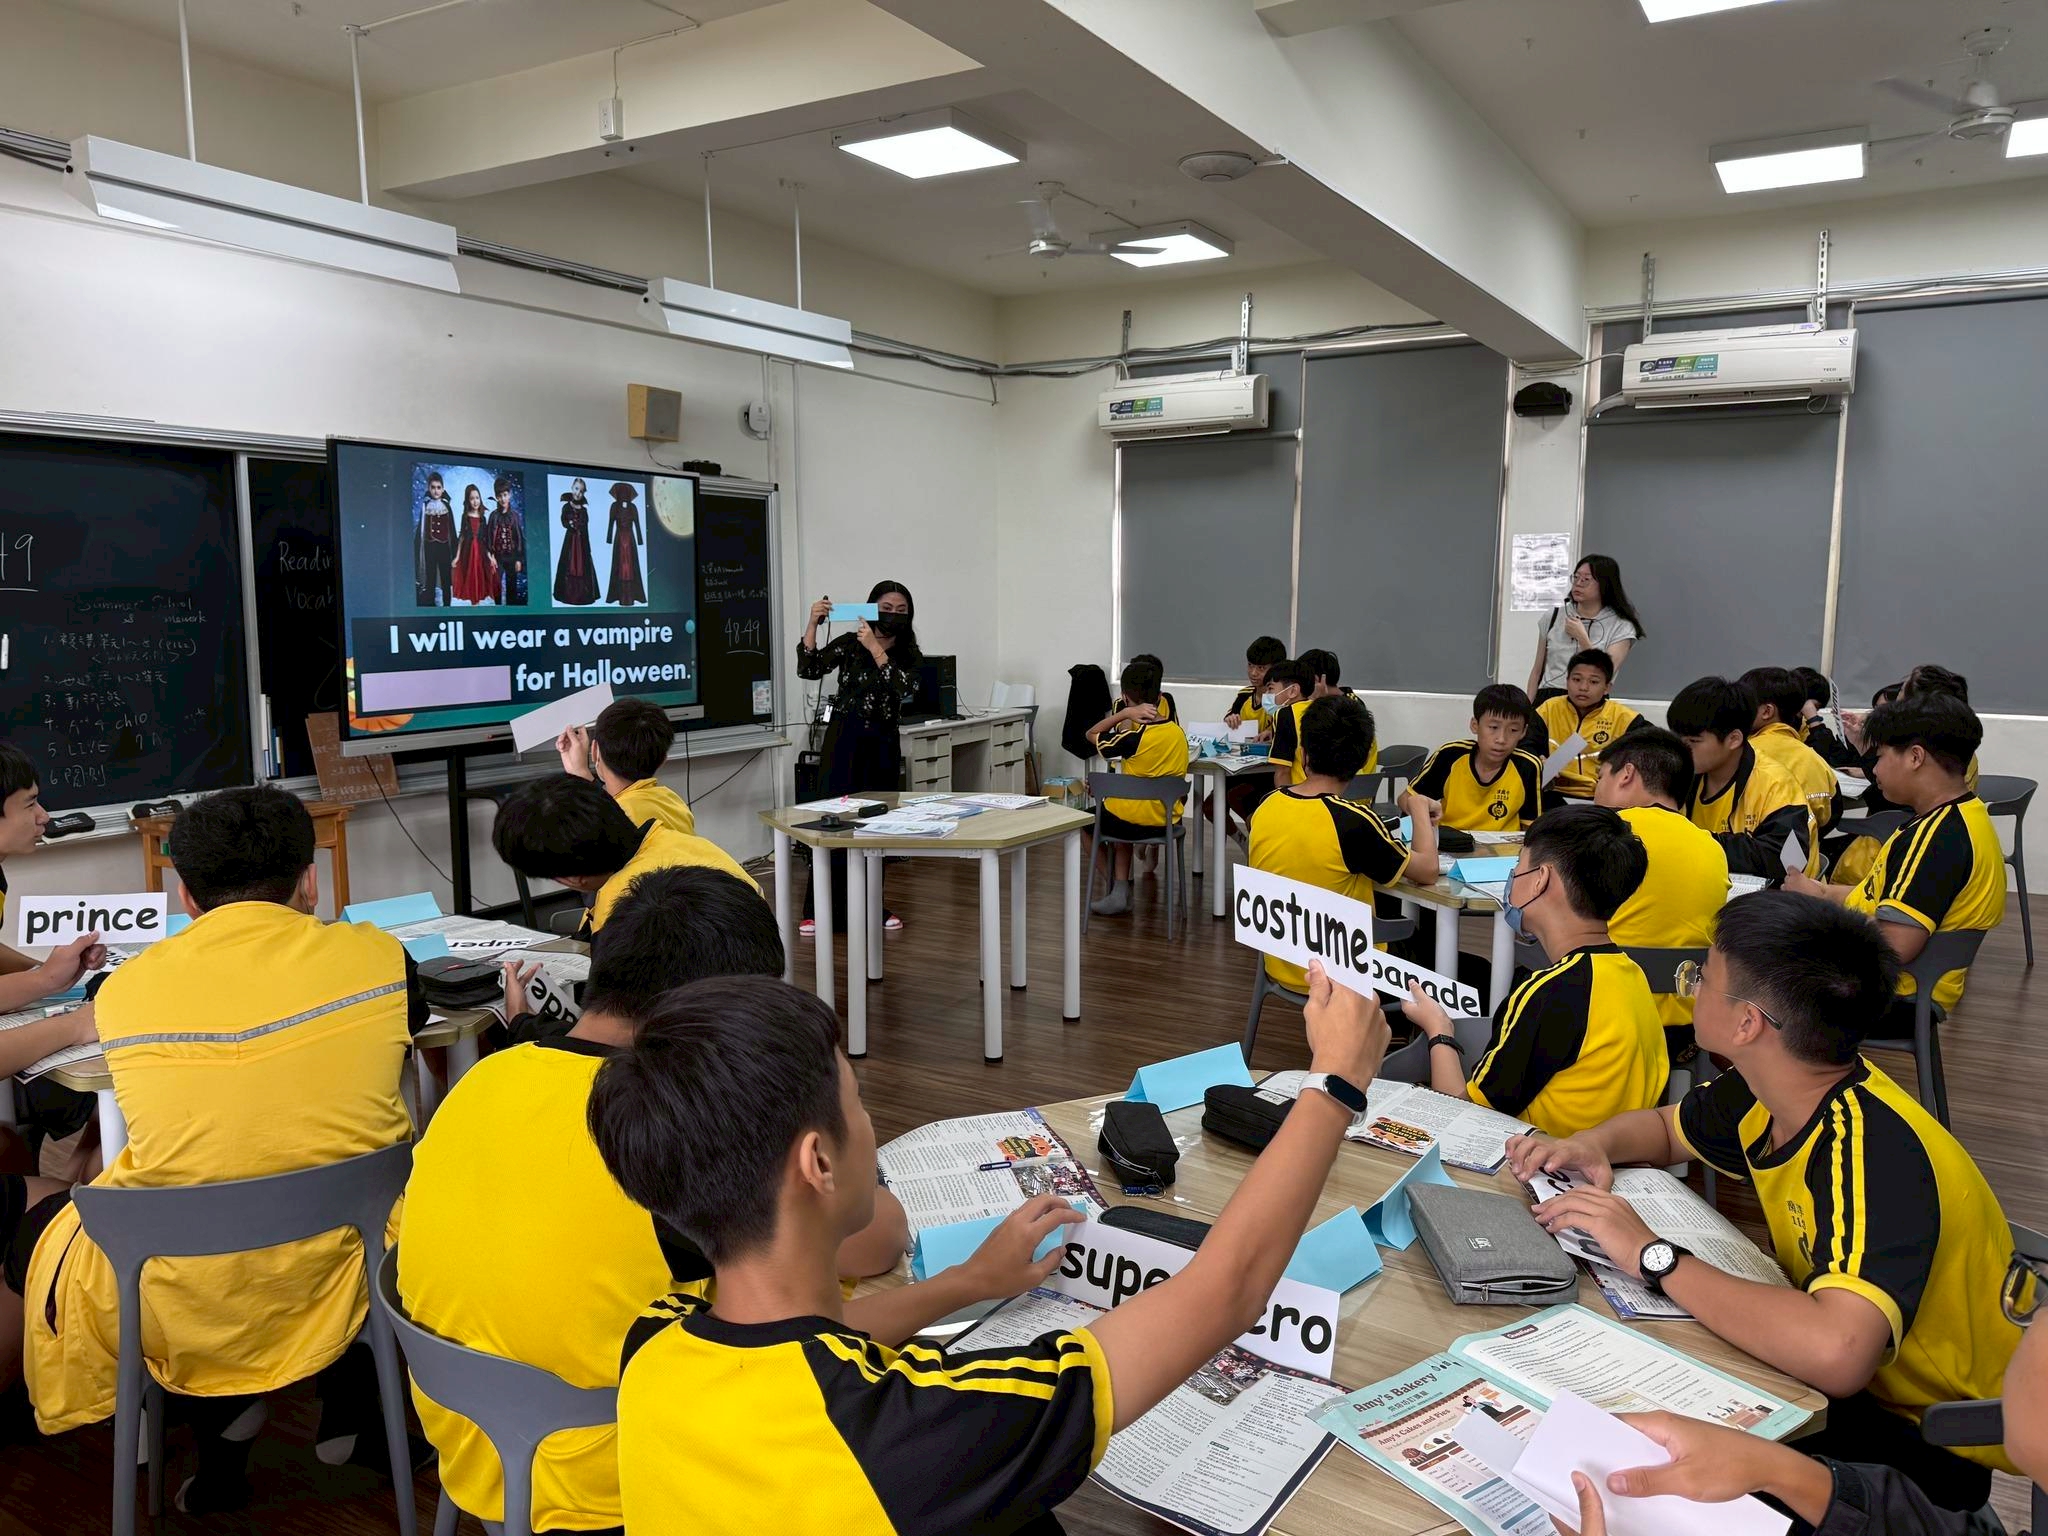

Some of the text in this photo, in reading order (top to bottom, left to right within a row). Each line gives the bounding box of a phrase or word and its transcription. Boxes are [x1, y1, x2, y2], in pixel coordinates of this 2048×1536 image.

[391, 619, 673, 653] I will wear a vampire
[516, 659, 691, 691] for Halloween.
[27, 901, 159, 944] prince
[1237, 889, 1369, 974] costume
[1060, 1242, 1332, 1354] supero
[1353, 1394, 1394, 1412] Amy's
[1390, 1372, 1438, 1397] Bakery
[1378, 1408, 1451, 1446] Amy's Cakes and Pies
